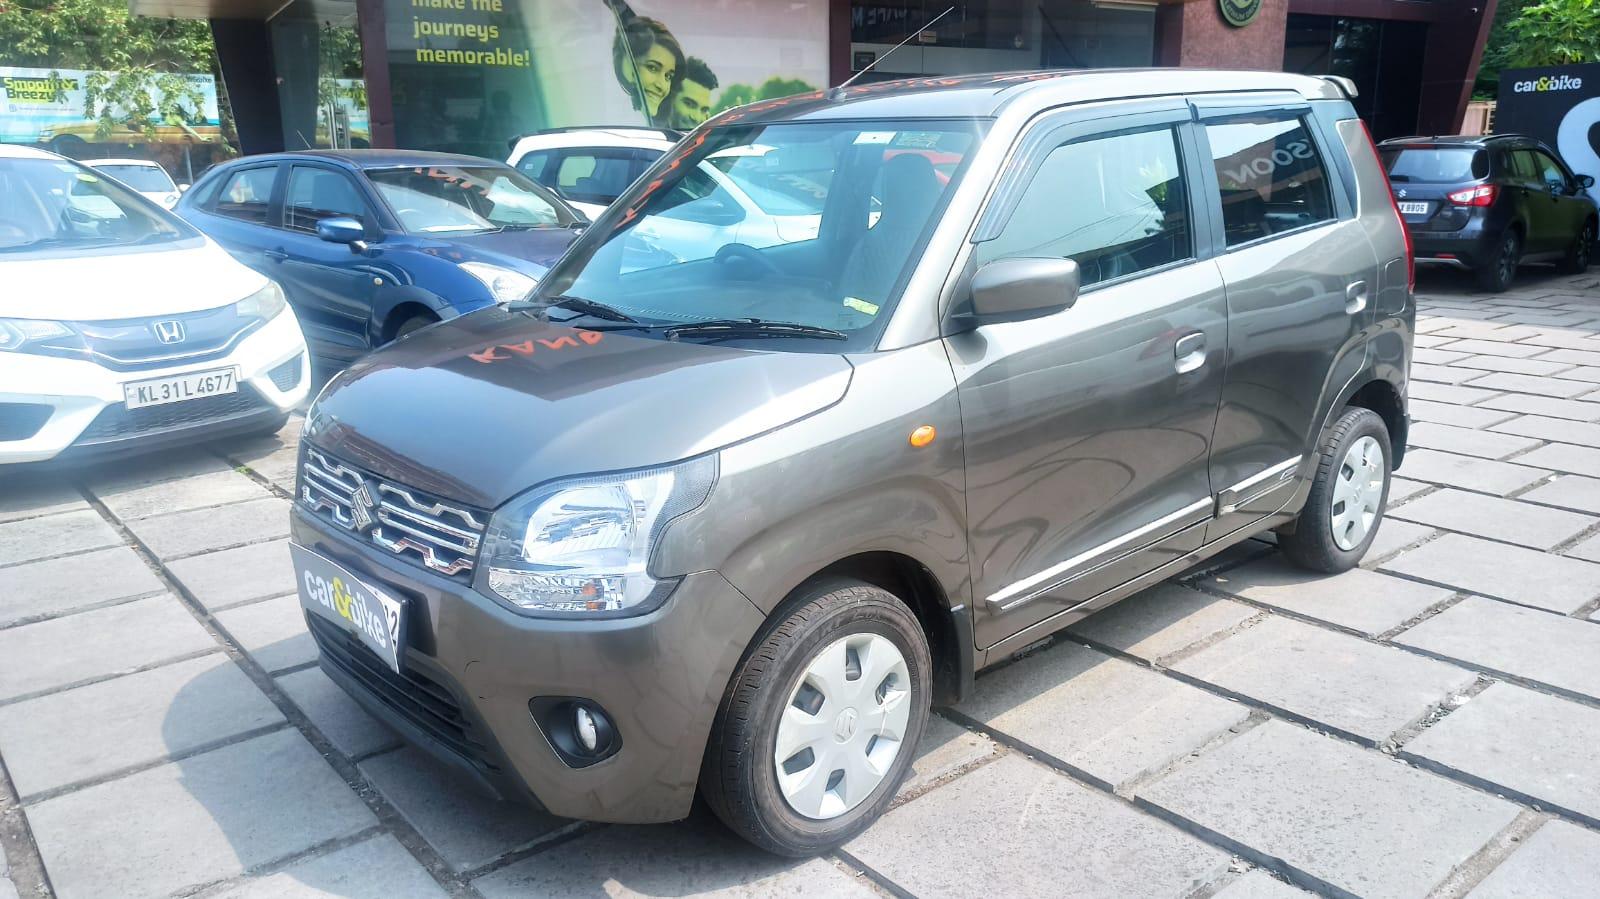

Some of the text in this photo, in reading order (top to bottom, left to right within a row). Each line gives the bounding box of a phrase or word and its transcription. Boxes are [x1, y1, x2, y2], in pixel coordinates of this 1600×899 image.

[413, 16, 499, 42] journeys
[416, 48, 530, 66] memorable!
[1514, 75, 1582, 92] car&bike
[137, 372, 233, 403] KL 31 L 4677
[304, 570, 387, 649] car&bike
